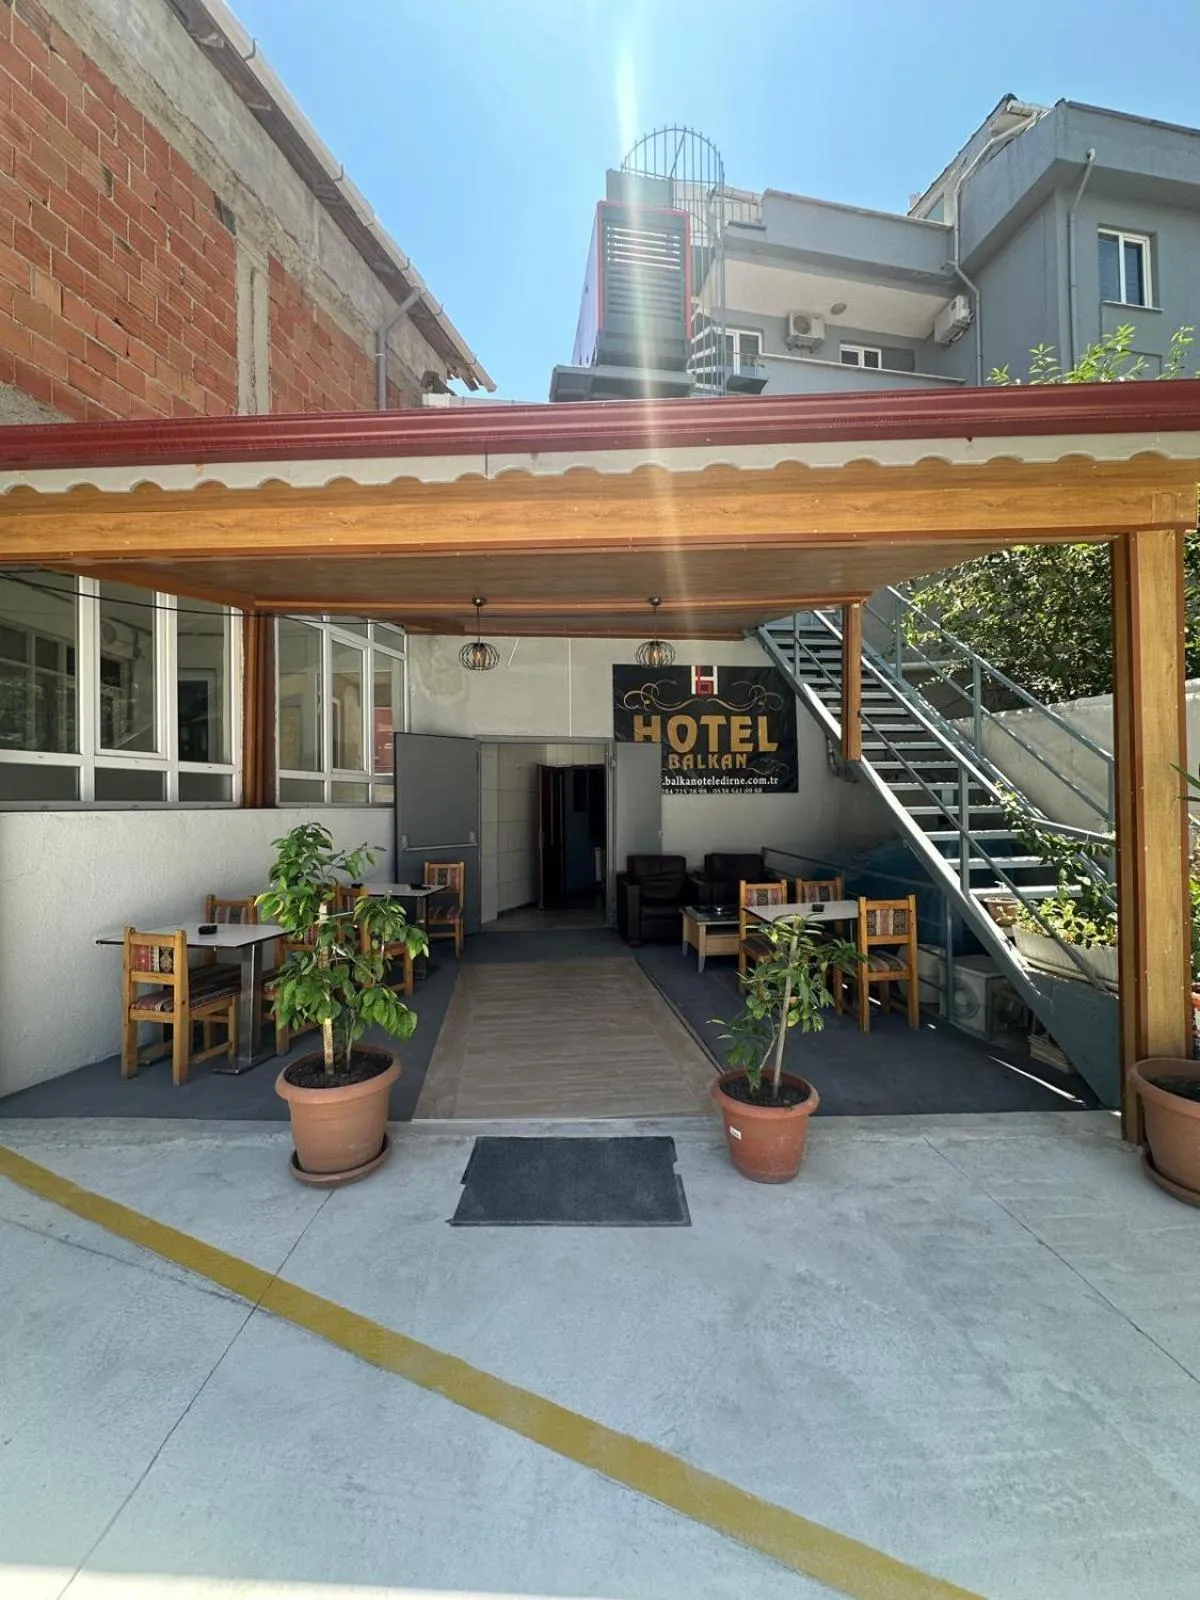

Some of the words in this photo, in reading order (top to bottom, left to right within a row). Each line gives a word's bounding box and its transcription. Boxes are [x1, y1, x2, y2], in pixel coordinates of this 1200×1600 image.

[633, 714, 778, 753] HOTEL
[668, 753, 747, 769] BALKAN
[661, 775, 779, 786] .balkanoteledirne.com.tr
